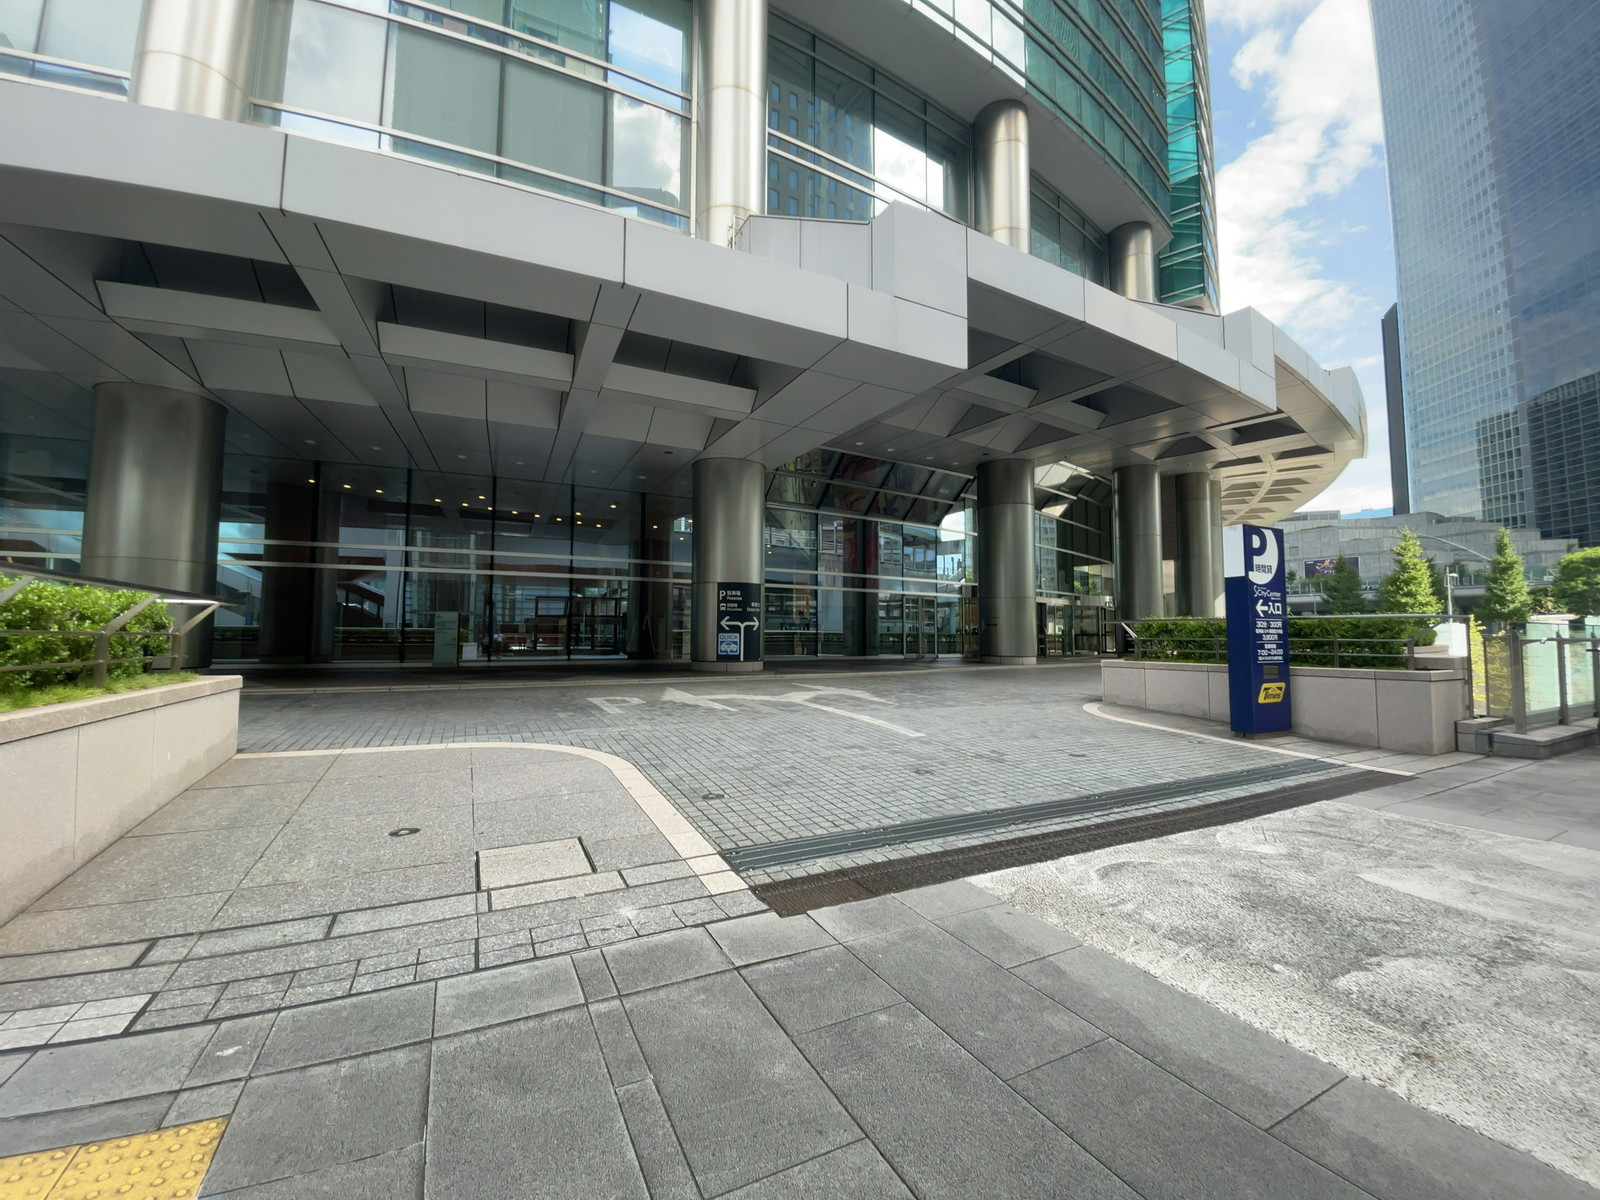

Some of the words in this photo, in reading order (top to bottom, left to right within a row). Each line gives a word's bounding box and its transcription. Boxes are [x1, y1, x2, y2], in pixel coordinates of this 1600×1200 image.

[1246, 526, 1268, 572] P
[1255, 564, 1273, 574] 時間貸
[720, 590, 726, 600] P
[1268, 602, 1282, 615] 入口
[1264, 687, 1283, 700] Times
